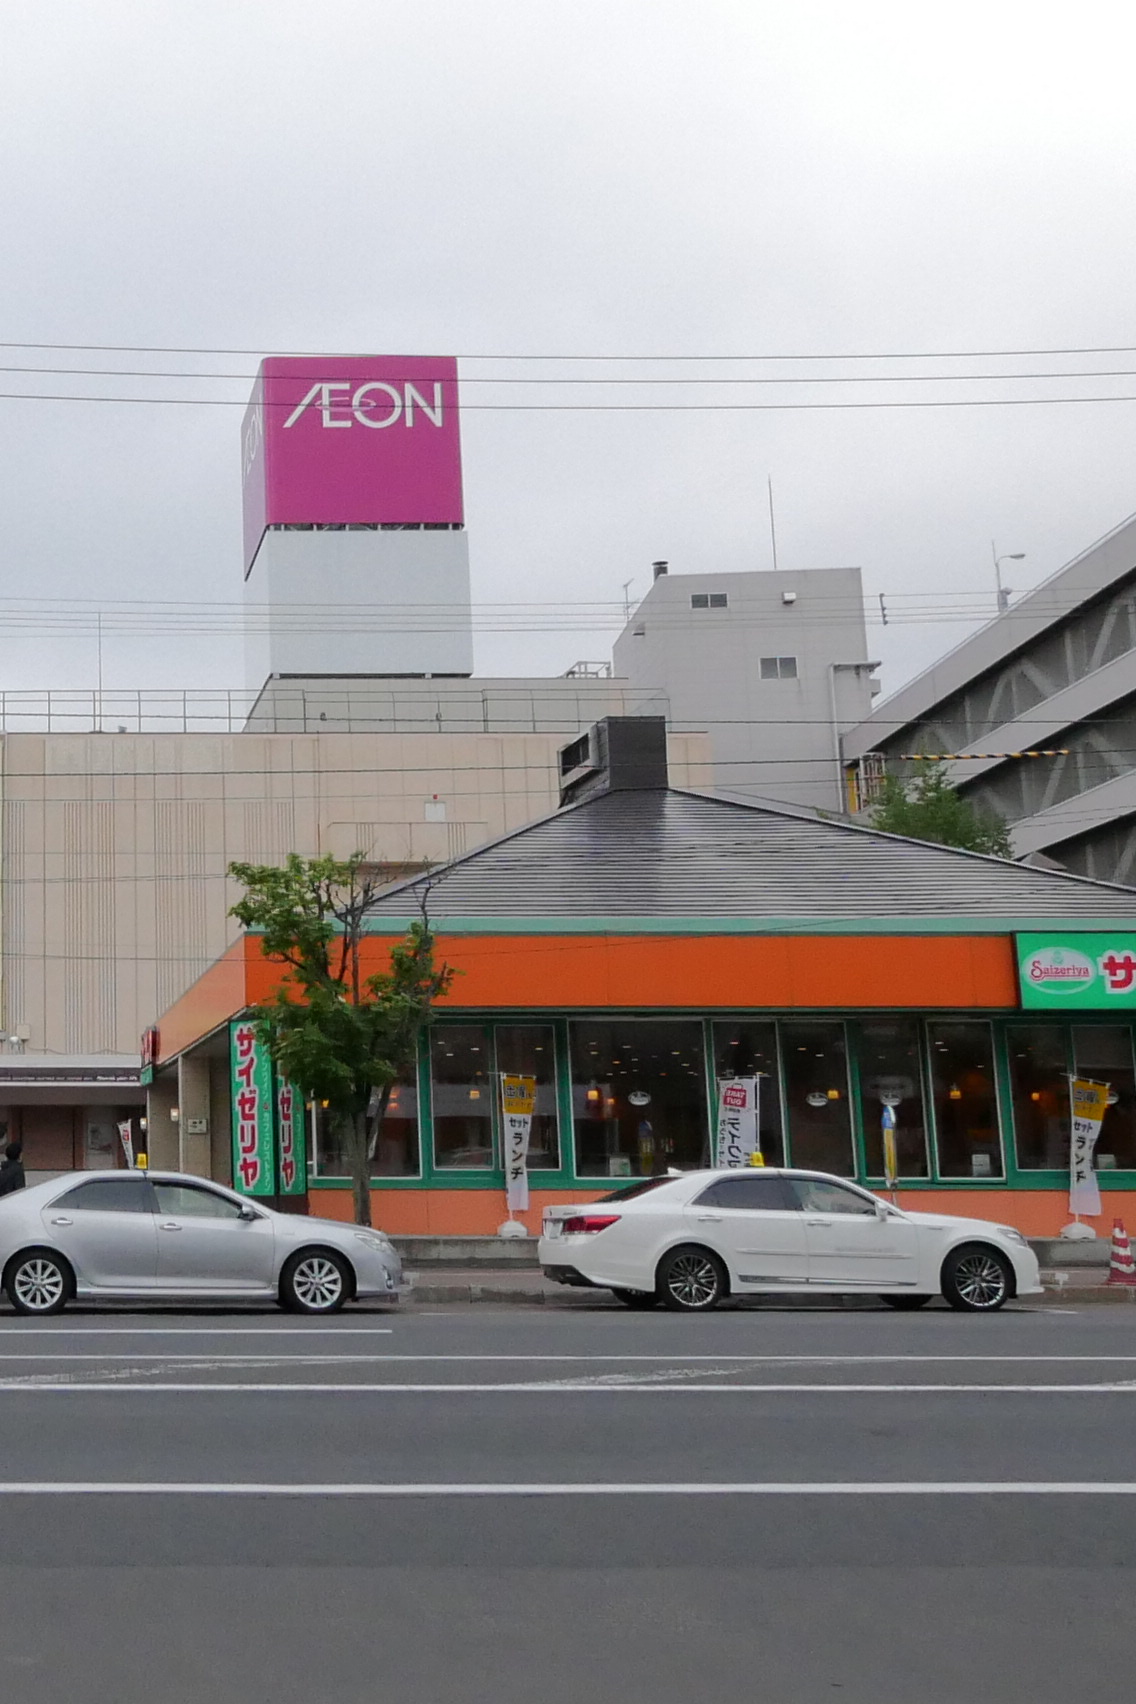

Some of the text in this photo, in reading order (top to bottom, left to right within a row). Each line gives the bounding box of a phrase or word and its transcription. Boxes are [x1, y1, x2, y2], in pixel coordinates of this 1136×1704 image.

[1030, 960, 1090, 981] Saizeriya
[236, 1027, 259, 1187] サイゼリヤ
[280, 1072, 295, 1188] ゼリヤ
[509, 1117, 529, 1128] セット
[1073, 1121, 1093, 1133] セット
[511, 1133, 524, 1180] ランチ
[1075, 1136, 1087, 1183] ランチ
